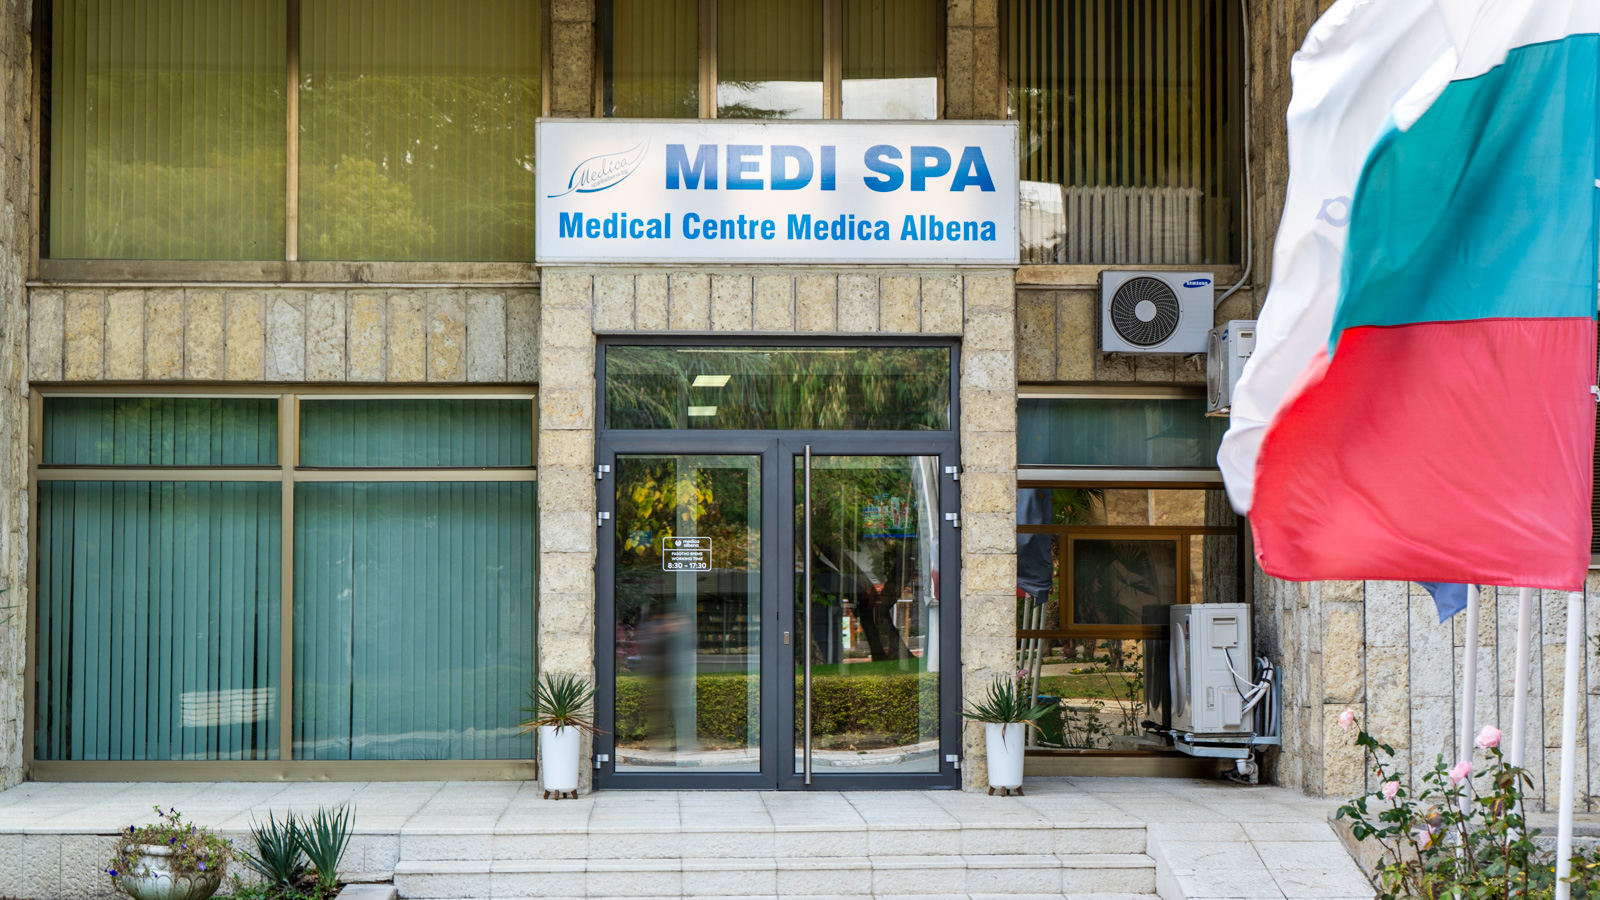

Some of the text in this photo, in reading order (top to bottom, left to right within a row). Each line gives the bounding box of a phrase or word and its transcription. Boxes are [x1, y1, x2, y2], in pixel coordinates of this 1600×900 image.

[580, 158, 628, 186] Medica
[665, 144, 997, 193] MEDI SPA
[559, 212, 997, 242] Medical Centre Medica Albena
